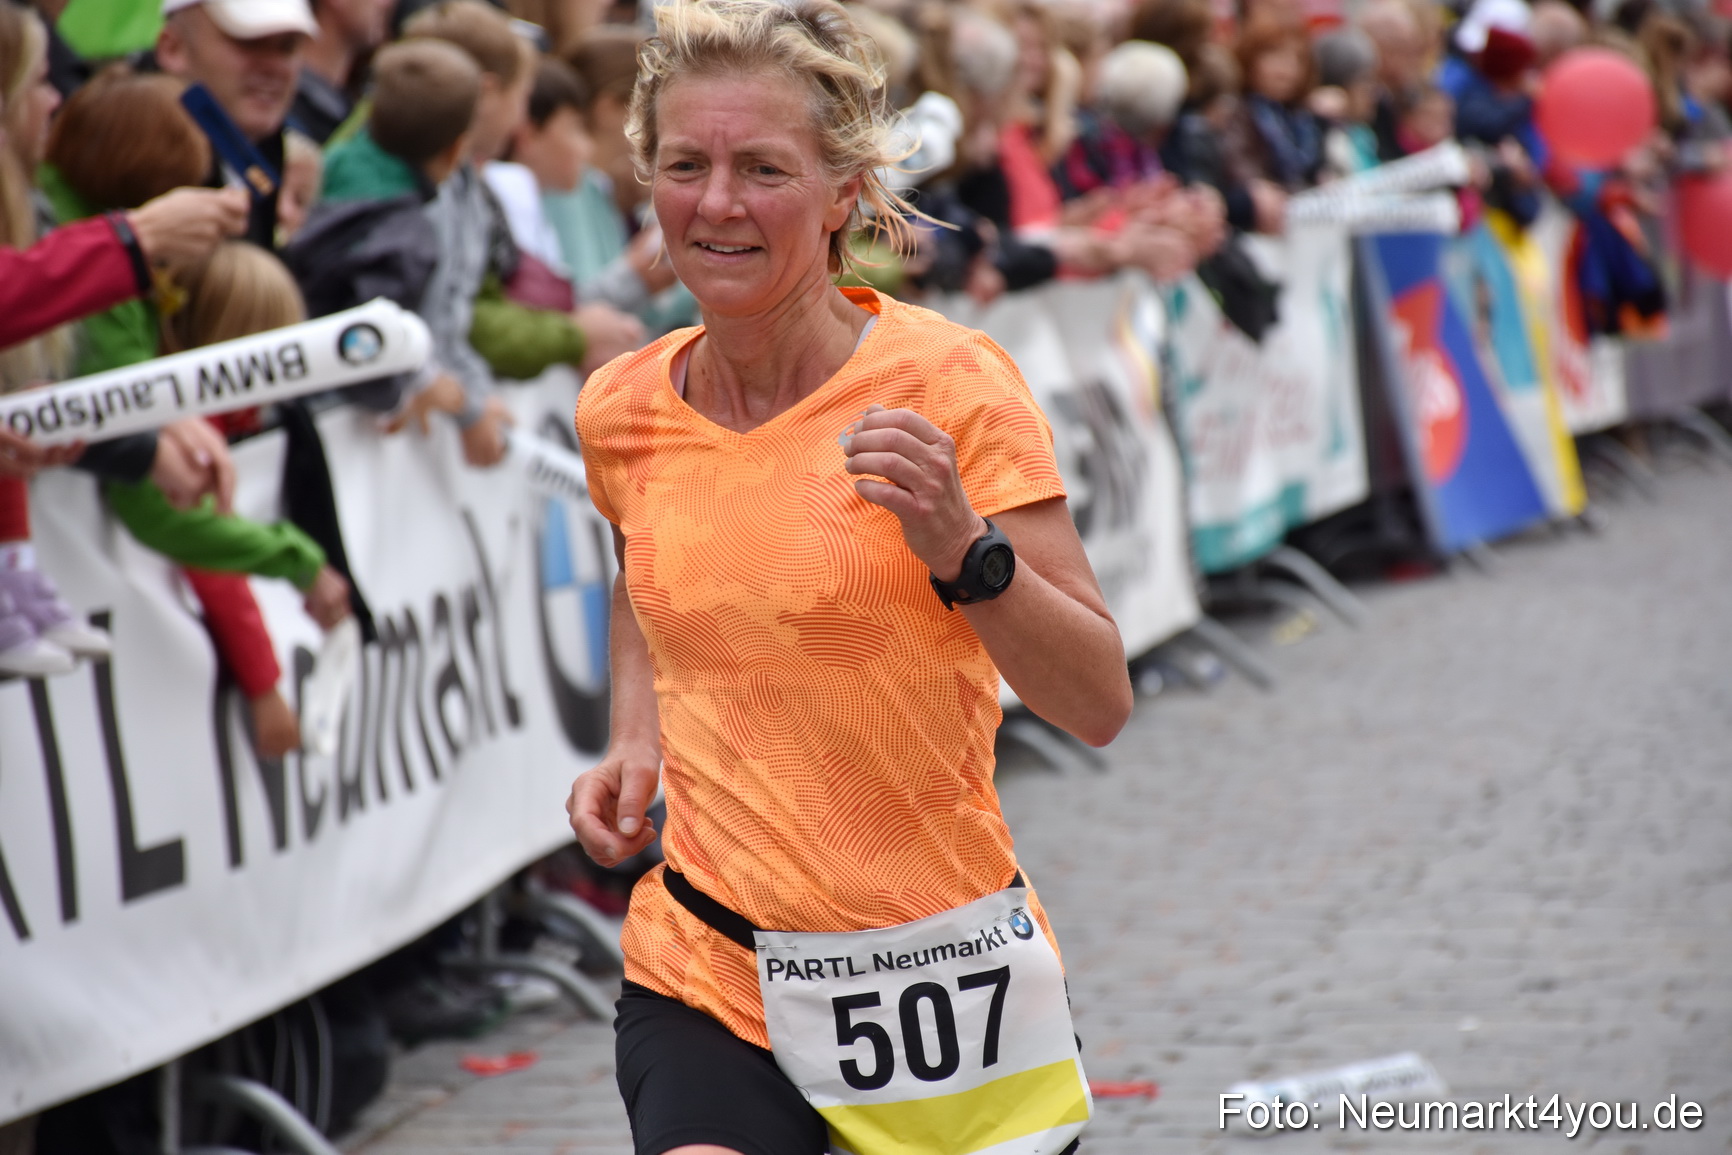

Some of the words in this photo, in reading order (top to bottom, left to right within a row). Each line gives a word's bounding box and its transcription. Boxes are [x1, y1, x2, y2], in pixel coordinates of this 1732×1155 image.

[196, 342, 308, 400] BMW
[3, 371, 185, 436] Laufspo
[766, 958, 866, 982] PARTL
[873, 925, 1008, 973] Neumarkt
[832, 965, 1011, 1091] 507
